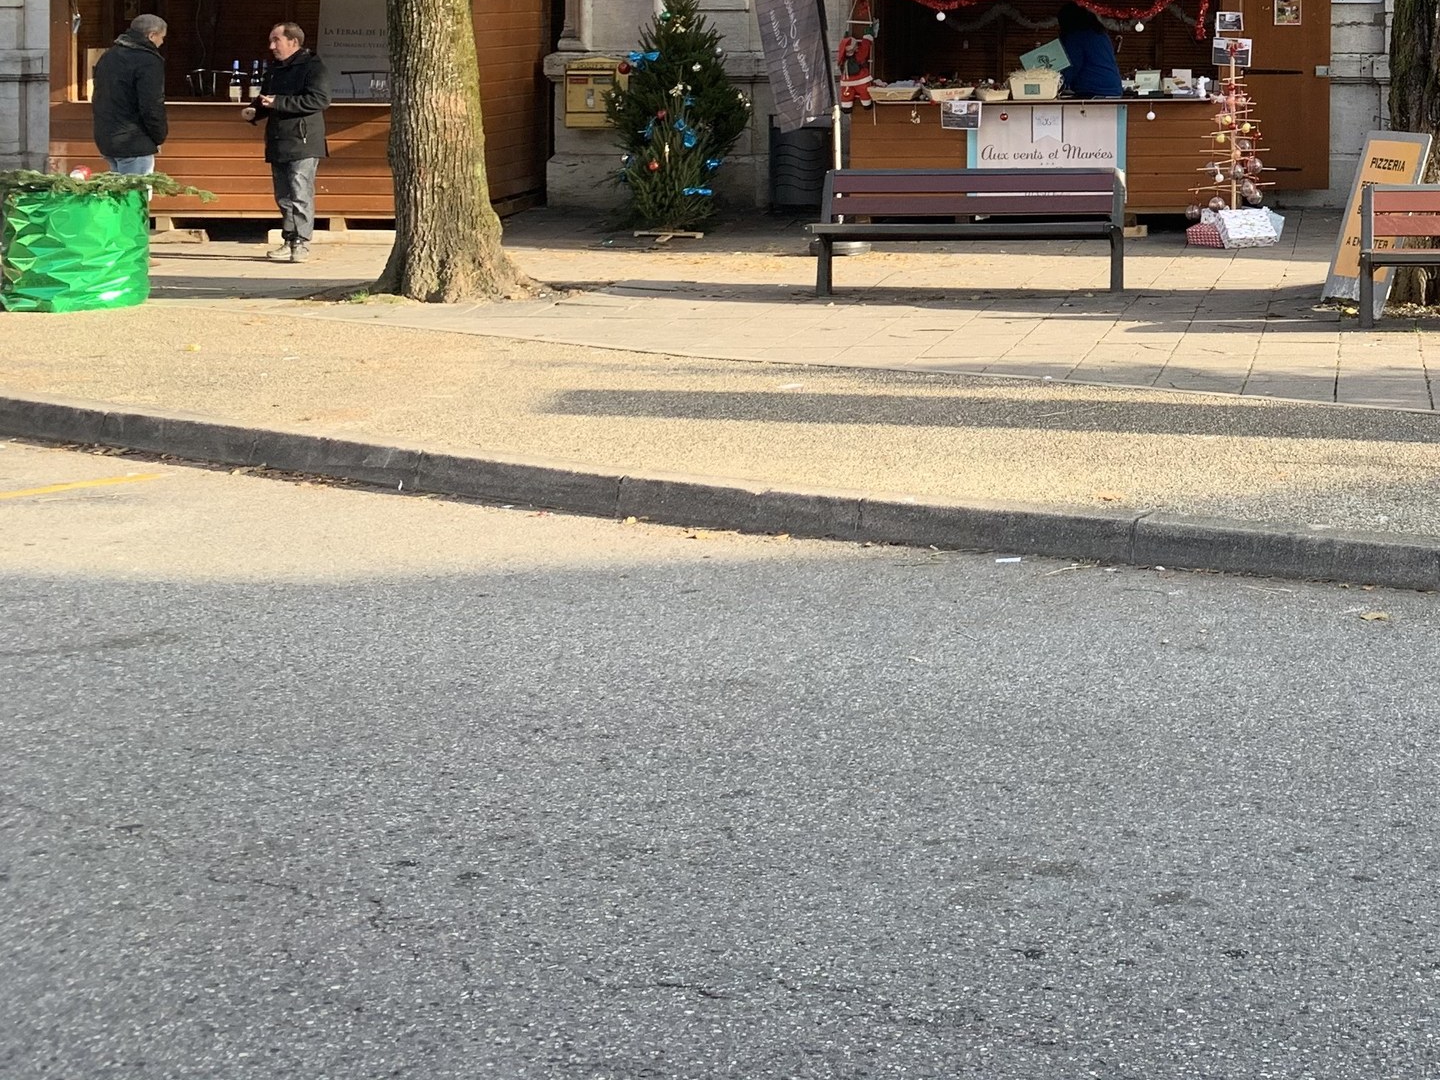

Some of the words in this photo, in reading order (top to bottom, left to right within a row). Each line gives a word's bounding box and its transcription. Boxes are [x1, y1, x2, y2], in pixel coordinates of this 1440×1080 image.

[981, 145, 1009, 160] Aux
[1013, 148, 1043, 160] vents
[1048, 148, 1059, 160] et
[1062, 143, 1113, 160] Marées
[1369, 157, 1406, 172] PIZZERIA
